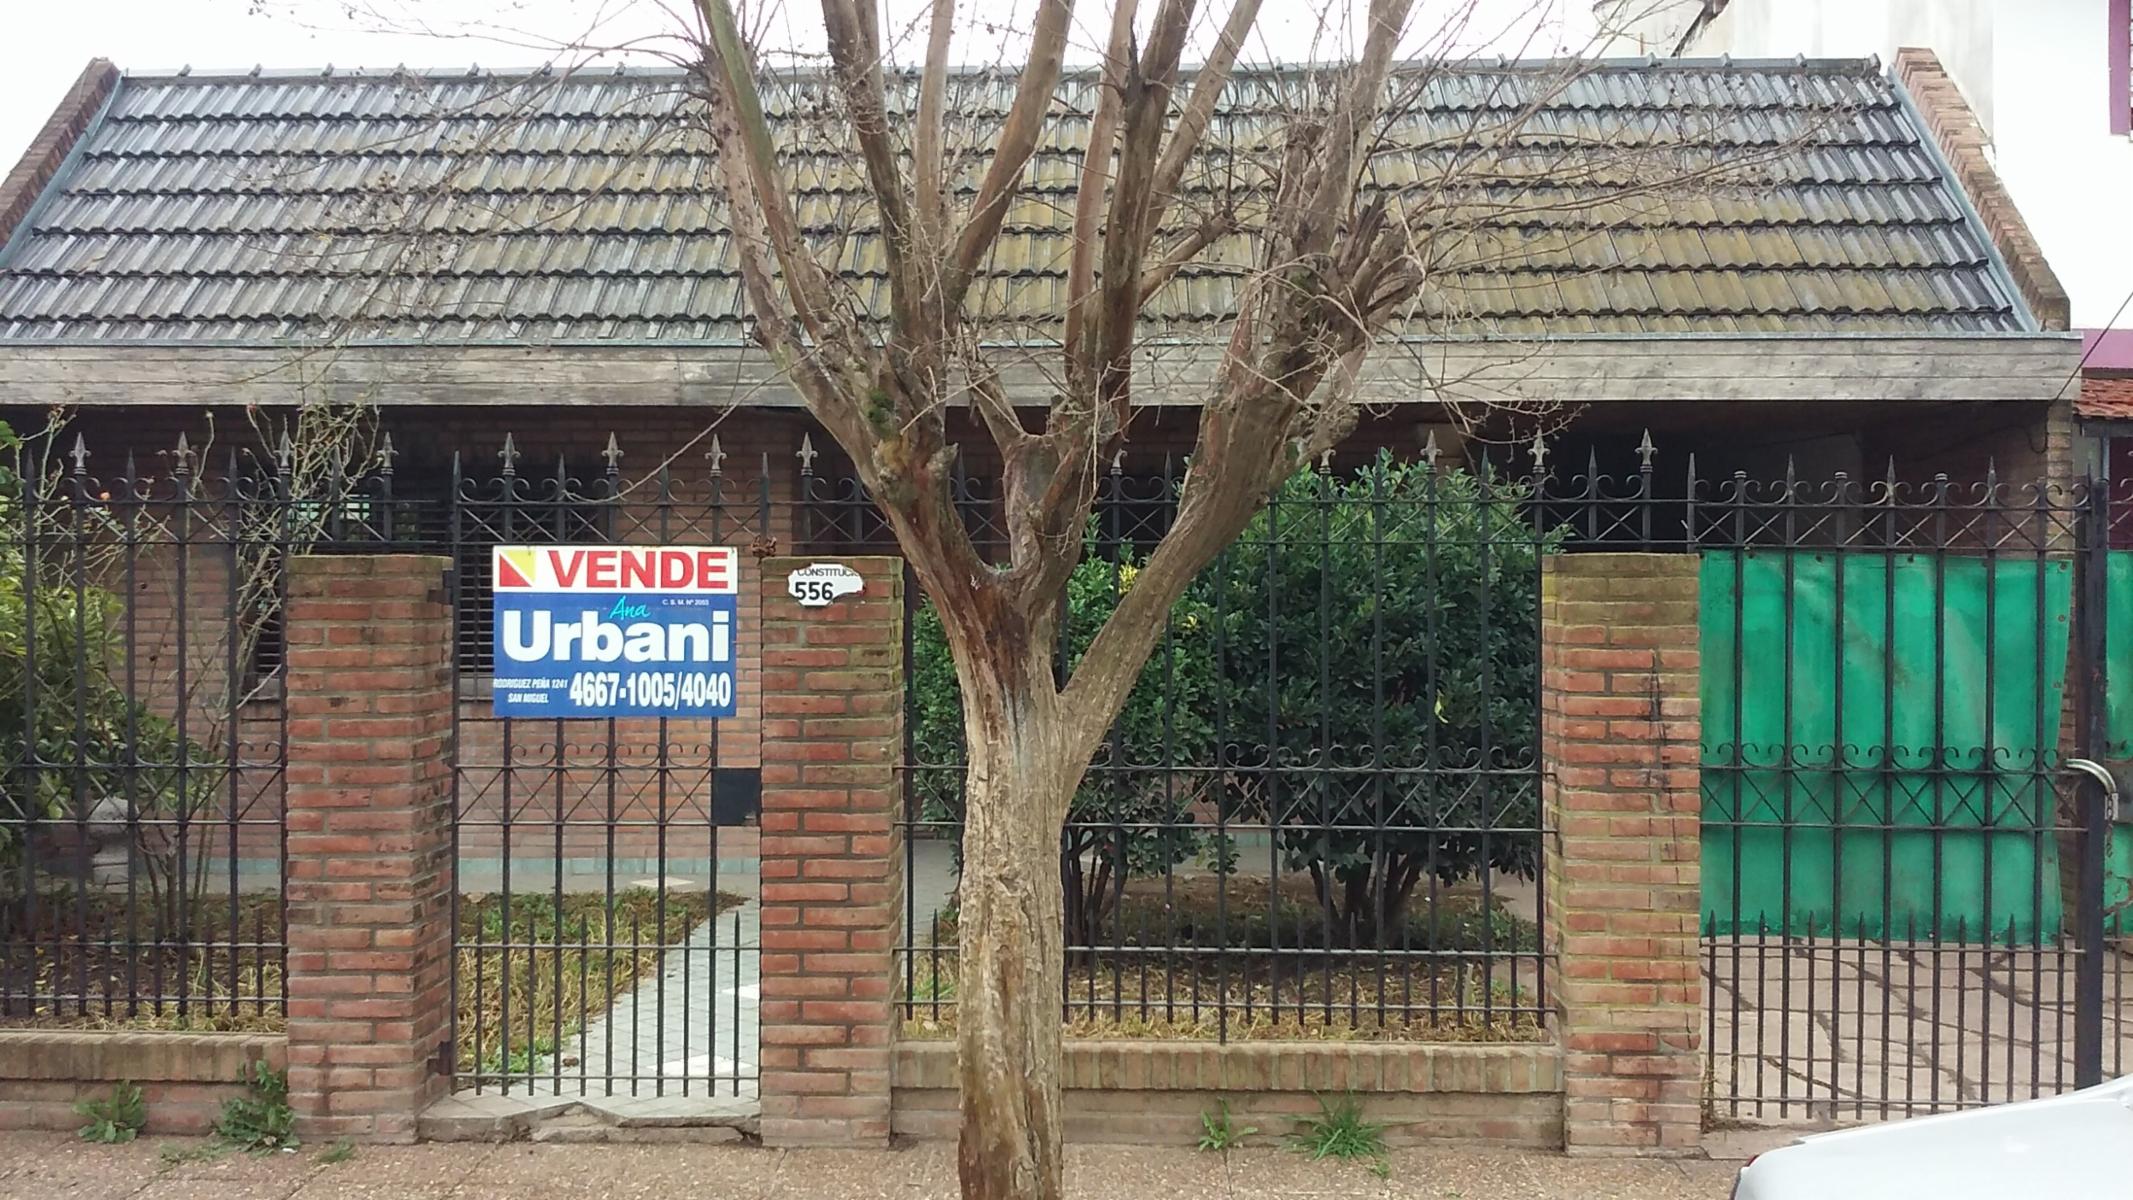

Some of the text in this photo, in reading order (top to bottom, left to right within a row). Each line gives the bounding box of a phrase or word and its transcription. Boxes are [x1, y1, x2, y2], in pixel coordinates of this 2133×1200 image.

[547, 550, 729, 589] VENDE
[797, 568, 859, 577] CONSTITUC
[795, 581, 833, 600] 556
[609, 595, 651, 620] Ana
[503, 610, 730, 663] Urbani
[493, 677, 569, 689] RODRIGUEZ PEÑA 1241
[569, 671, 731, 711] 4667-1005/4040
[508, 693, 549, 704] SAN MIGUEL
